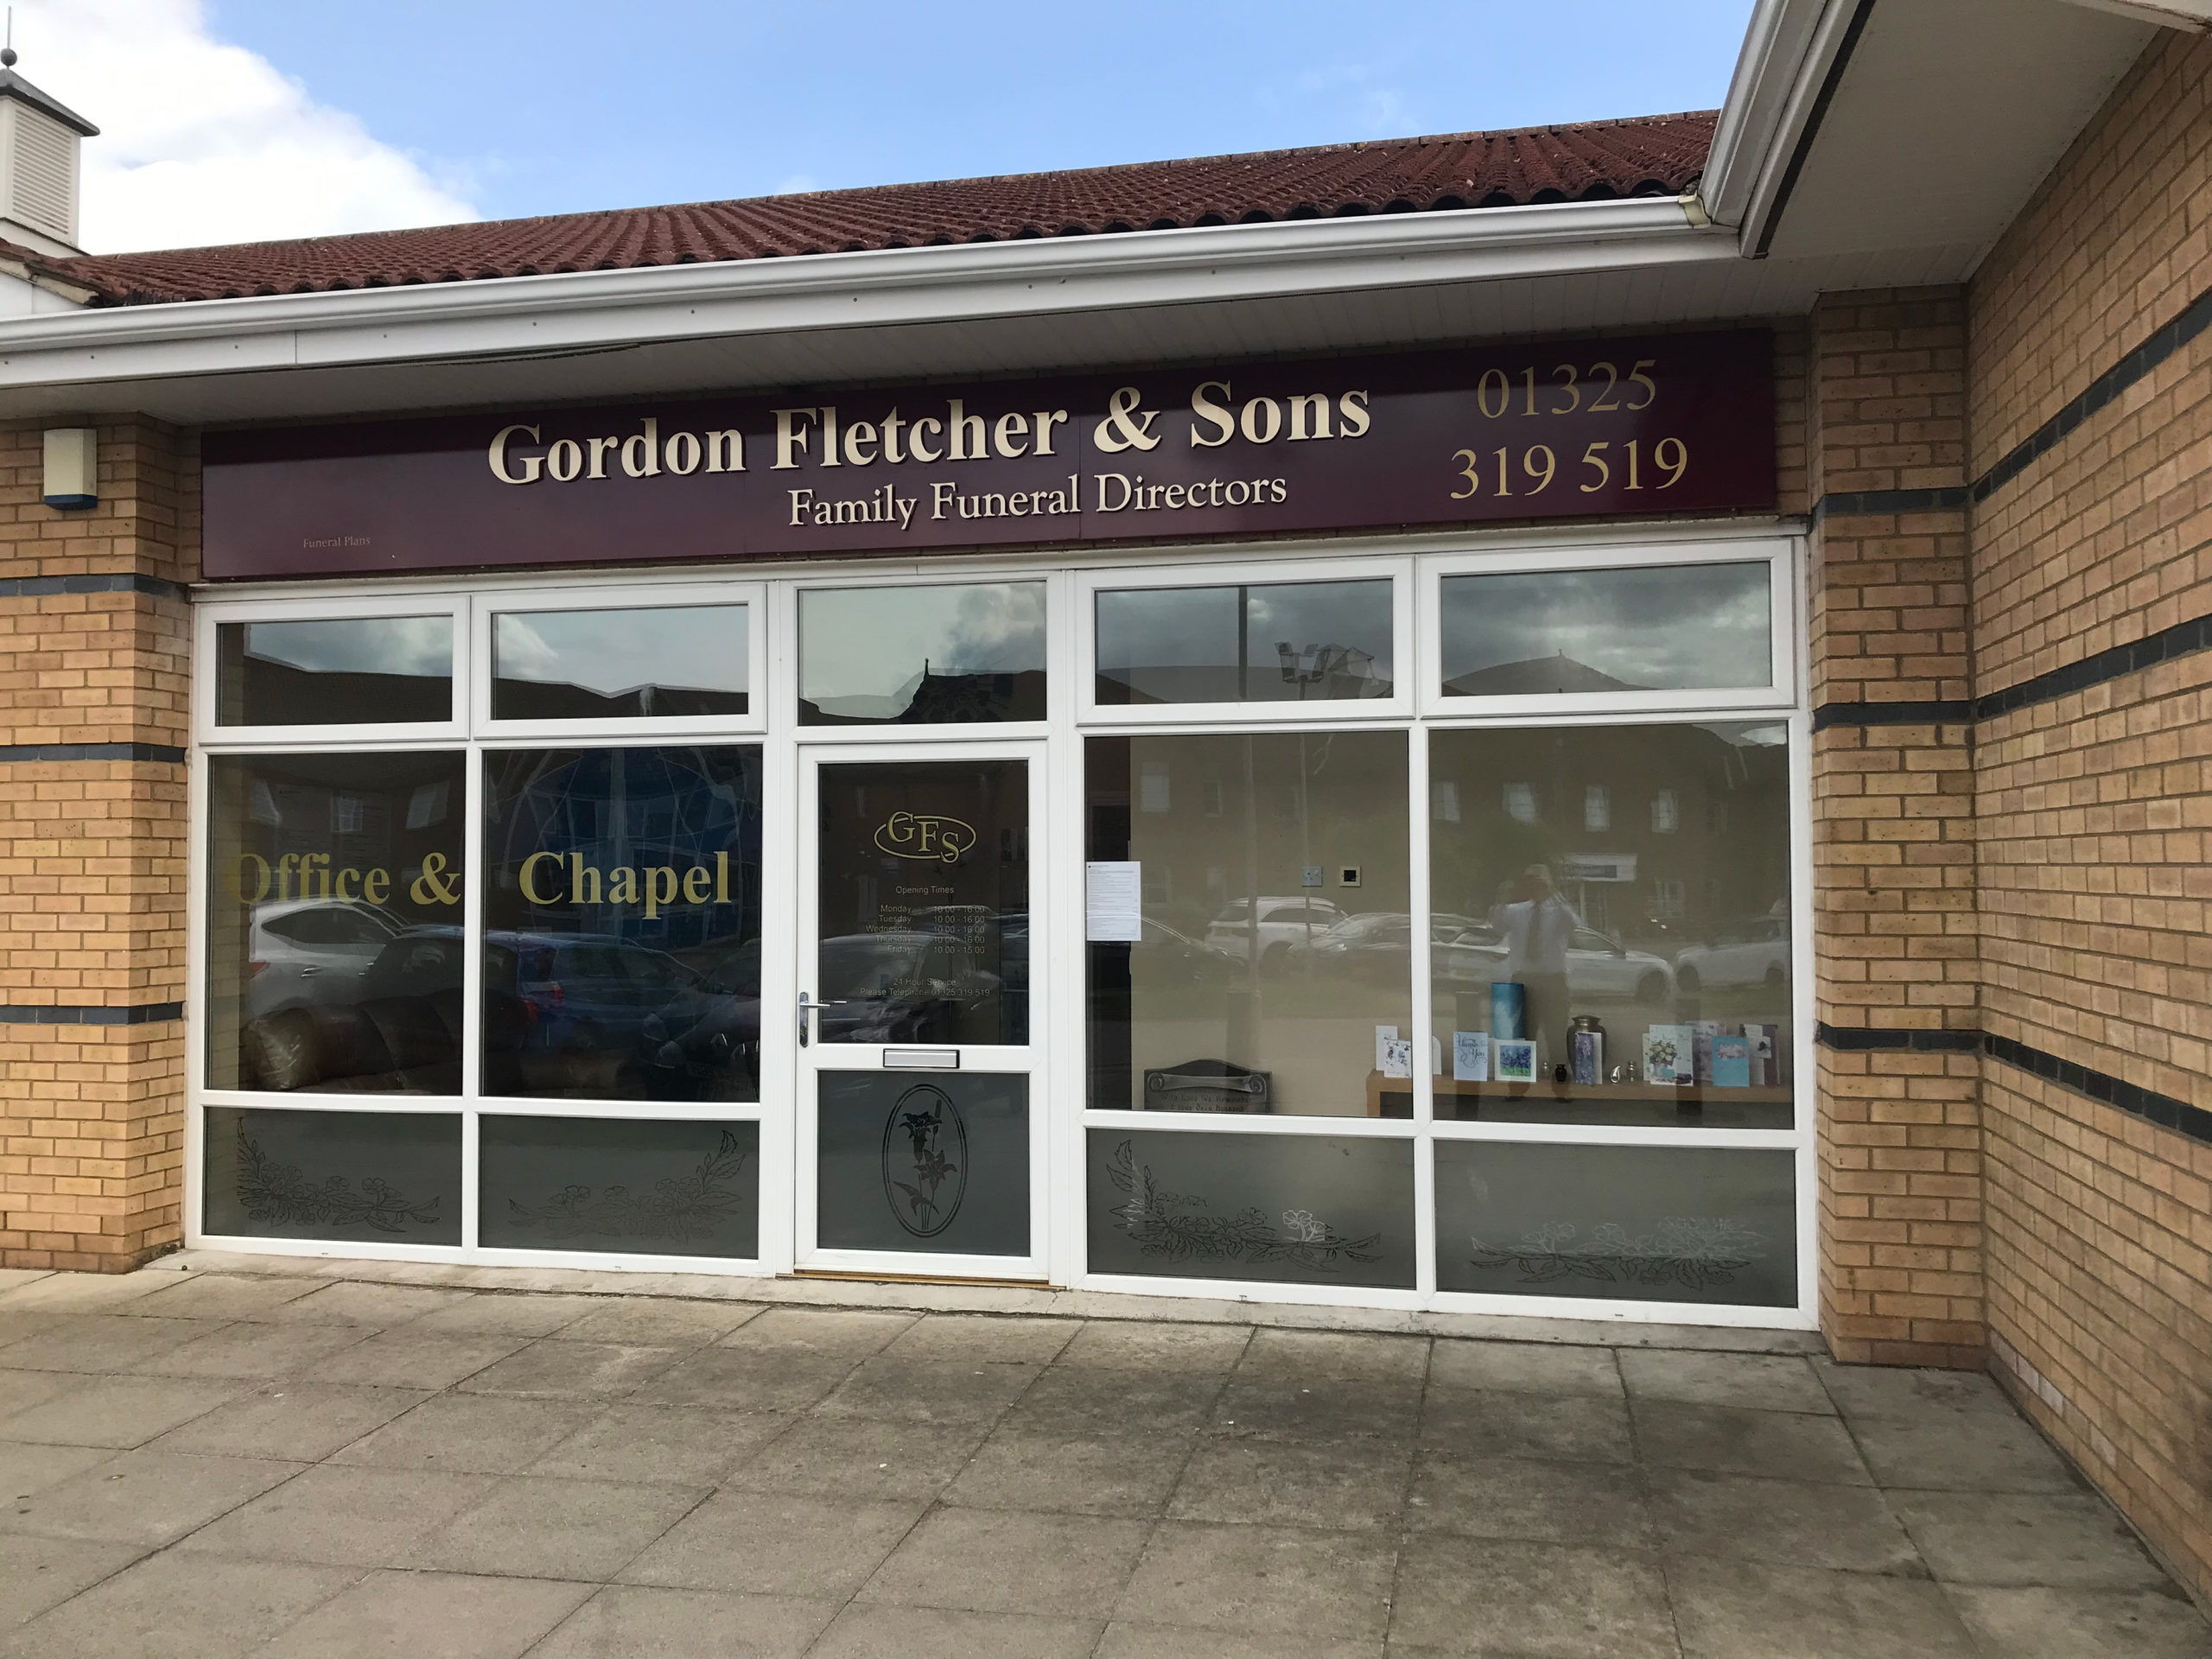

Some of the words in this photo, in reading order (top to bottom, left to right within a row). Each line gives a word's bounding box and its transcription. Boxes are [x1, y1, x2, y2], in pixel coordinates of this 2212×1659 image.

[1477, 359, 1656, 419] 01325
[488, 417, 747, 484] Gordon
[770, 398, 1068, 470] Fletcher
[1093, 386, 1162, 454] &
[1191, 380, 1371, 448] Sons
[1450, 444, 1556, 499] 319
[1580, 437, 1688, 493] 519
[787, 483, 918, 531] Family
[930, 474, 1082, 520] Funeral
[1093, 473, 1287, 512] Directors
[303, 537, 341, 548] Funeral
[344, 536, 371, 546] Plans
[887, 811, 959, 863] GFS
[232, 852, 391, 906] Office
[410, 852, 461, 906] &
[518, 850, 733, 920] Chapel
[895, 886, 929, 895] Opening
[931, 885, 955, 893] Times
[880, 905, 912, 914] Monday
[879, 914, 912, 924] Tuesday
[866, 925, 912, 934] Wednesday
[887, 945, 912, 954] Friday
[958, 988, 973, 996] 319
[975, 988, 990, 996] 519
